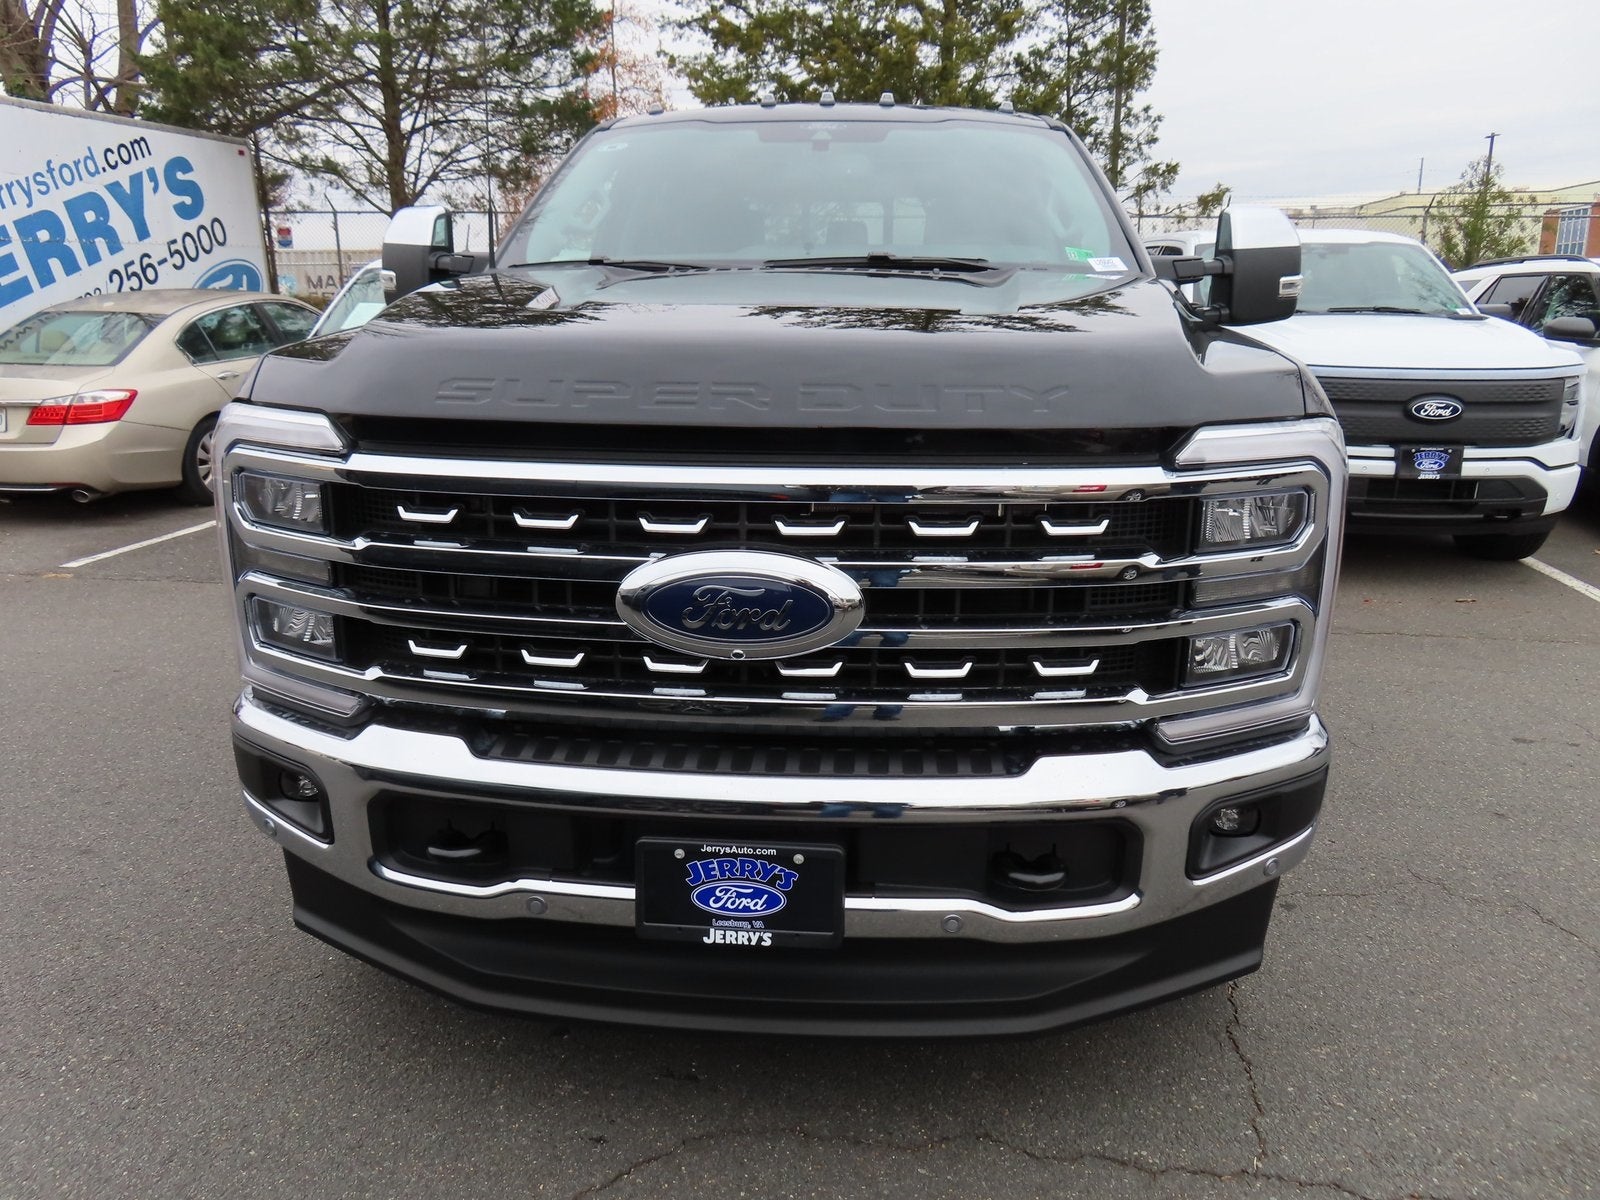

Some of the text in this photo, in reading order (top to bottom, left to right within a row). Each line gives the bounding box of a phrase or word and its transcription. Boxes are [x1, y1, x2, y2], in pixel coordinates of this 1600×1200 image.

[108, 217, 228, 293] 256-5000
[435, 377, 1069, 412] SUPER DUTY
[1420, 403, 1453, 417] Ford
[681, 584, 794, 631] Ford
[700, 844, 777, 856] JerrysAuto.com
[685, 857, 799, 891] JERRY'S
[709, 886, 769, 911] Ford
[752, 920, 765, 929] VA
[702, 928, 773, 947] JERRY'S
